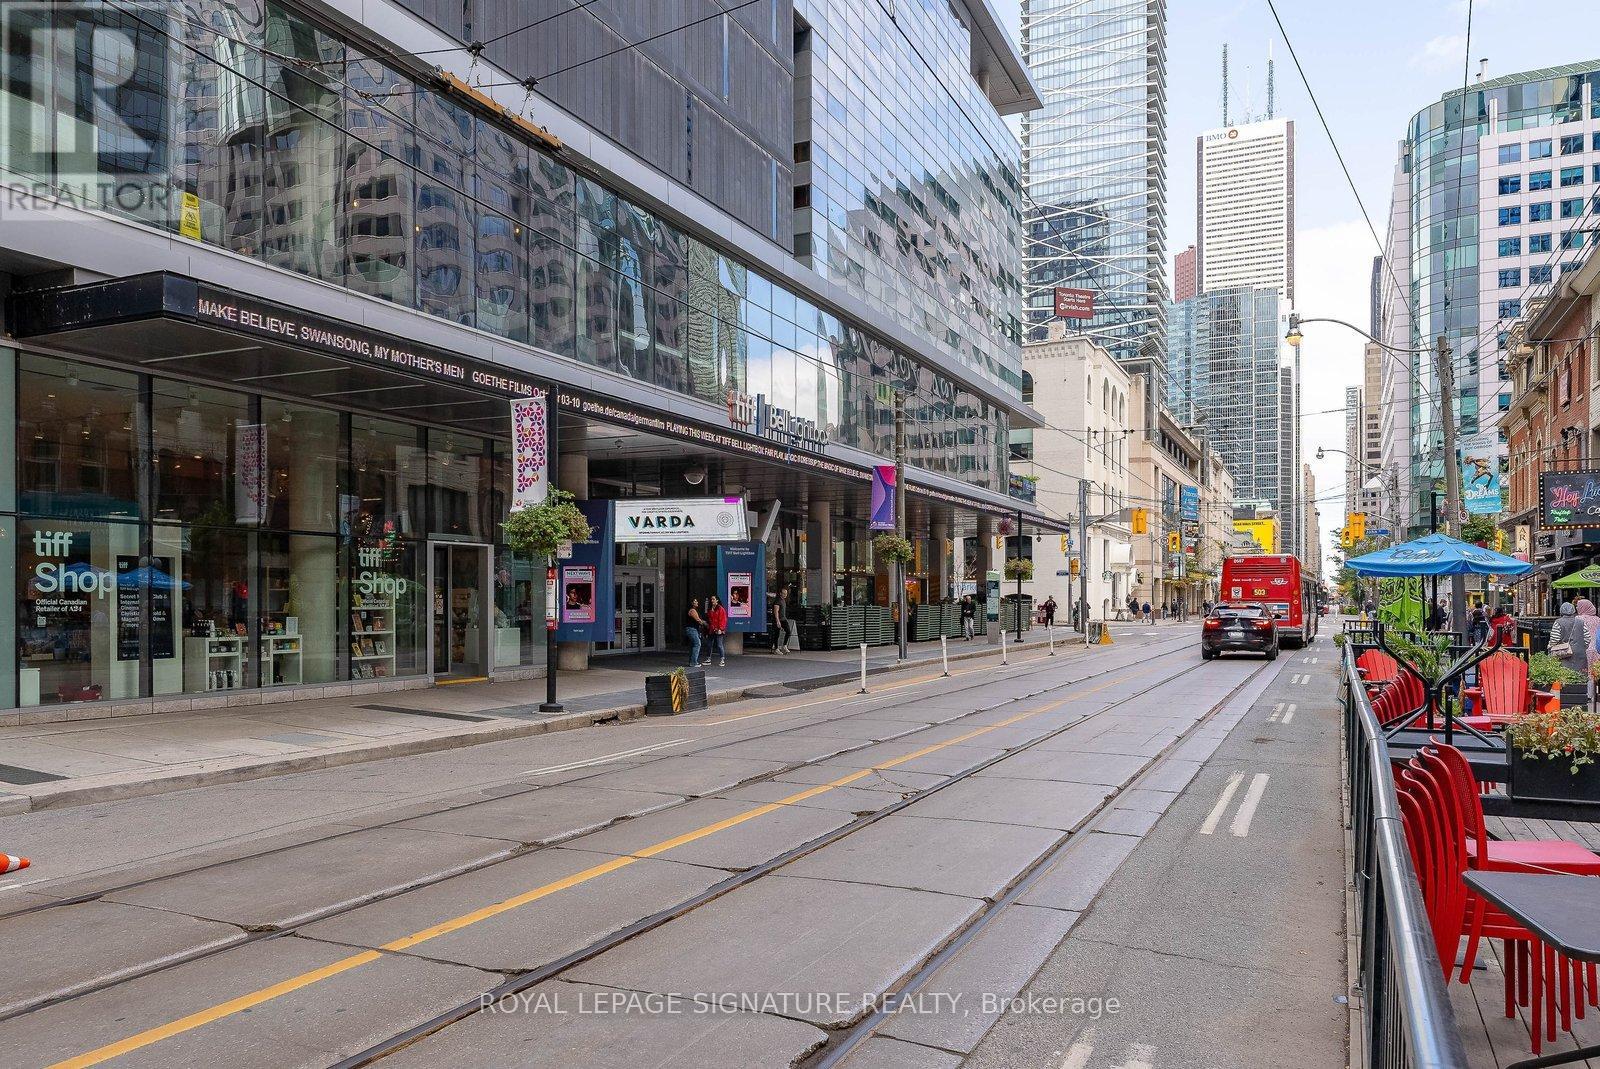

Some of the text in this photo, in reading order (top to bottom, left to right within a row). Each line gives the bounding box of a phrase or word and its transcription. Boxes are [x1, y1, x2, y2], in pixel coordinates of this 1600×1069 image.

[1206, 133, 1226, 142] BMO
[198, 299, 238, 322] MAKE
[240, 310, 298, 340] BELIEVE,
[301, 326, 372, 358] SWANSONG,
[374, 345, 389, 360] MY
[391, 349, 442, 374] MOTHER'S
[443, 363, 464, 380] MEN
[472, 371, 508, 390] GOETHE
[508, 380, 532, 397] FILMS
[561, 394, 580, 408] 03-10
[666, 421, 688, 436] PLAYING
[689, 427, 701, 439] THIS
[1550, 485, 1580, 508] Hey
[628, 515, 696, 528] VARDA
[32, 530, 73, 557] tiff
[358, 547, 382, 568] tiff
[35, 562, 116, 600] Shop
[360, 571, 407, 600] Shop
